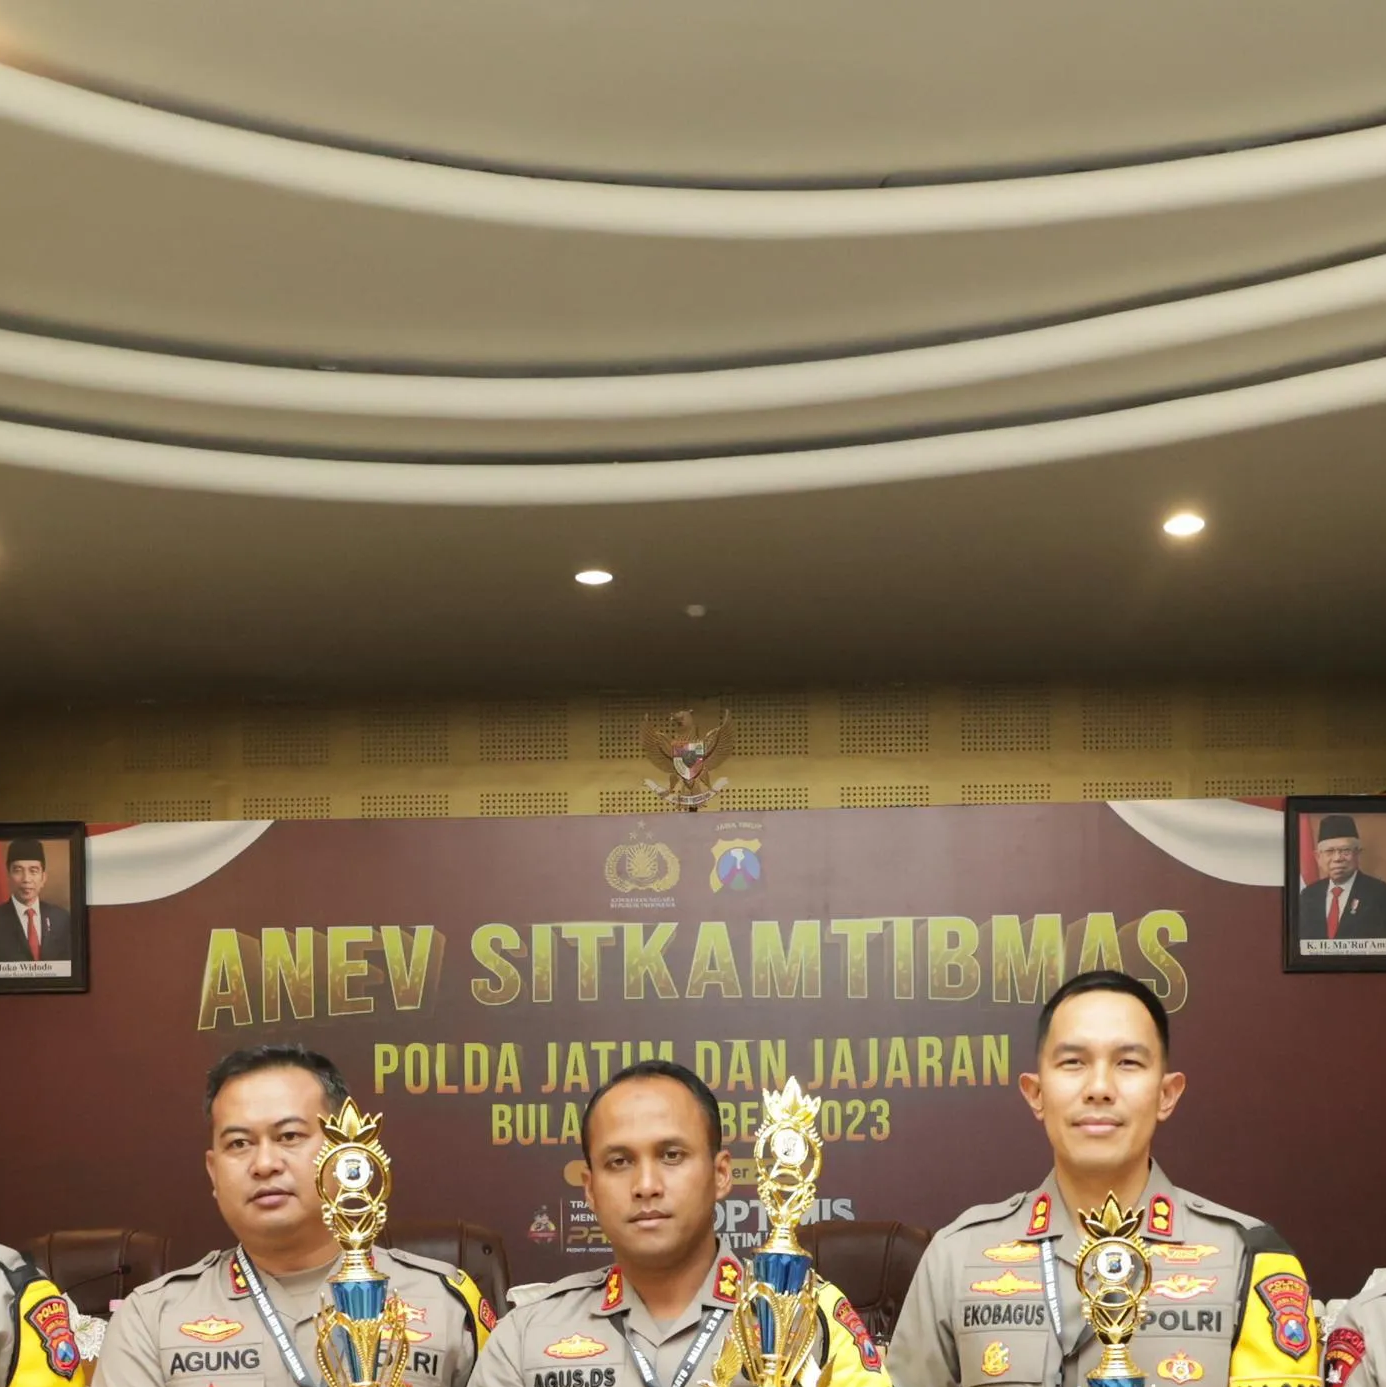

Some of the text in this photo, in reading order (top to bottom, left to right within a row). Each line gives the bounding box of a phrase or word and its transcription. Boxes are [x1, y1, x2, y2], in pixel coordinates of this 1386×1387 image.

[1307, 942, 1317, 950] K.
[20, 963, 53, 972] Widodo
[197, 908, 1189, 1031] ANEV SITKAMTIBMAS
[374, 1042, 522, 1095] POLDA
[695, 1038, 787, 1091] DAN
[808, 1034, 1010, 1090] JAJARAN
[492, 1098, 891, 1146] BULA 023
[717, 1232, 761, 1249] ATIM
[36, 1302, 65, 1324] POLDA
[705, 1318, 719, 1331] 23
[963, 1303, 1046, 1328] EKOBAGUS
[1139, 1309, 1222, 1333] POLRI
[170, 1349, 260, 1376] AGUNG
